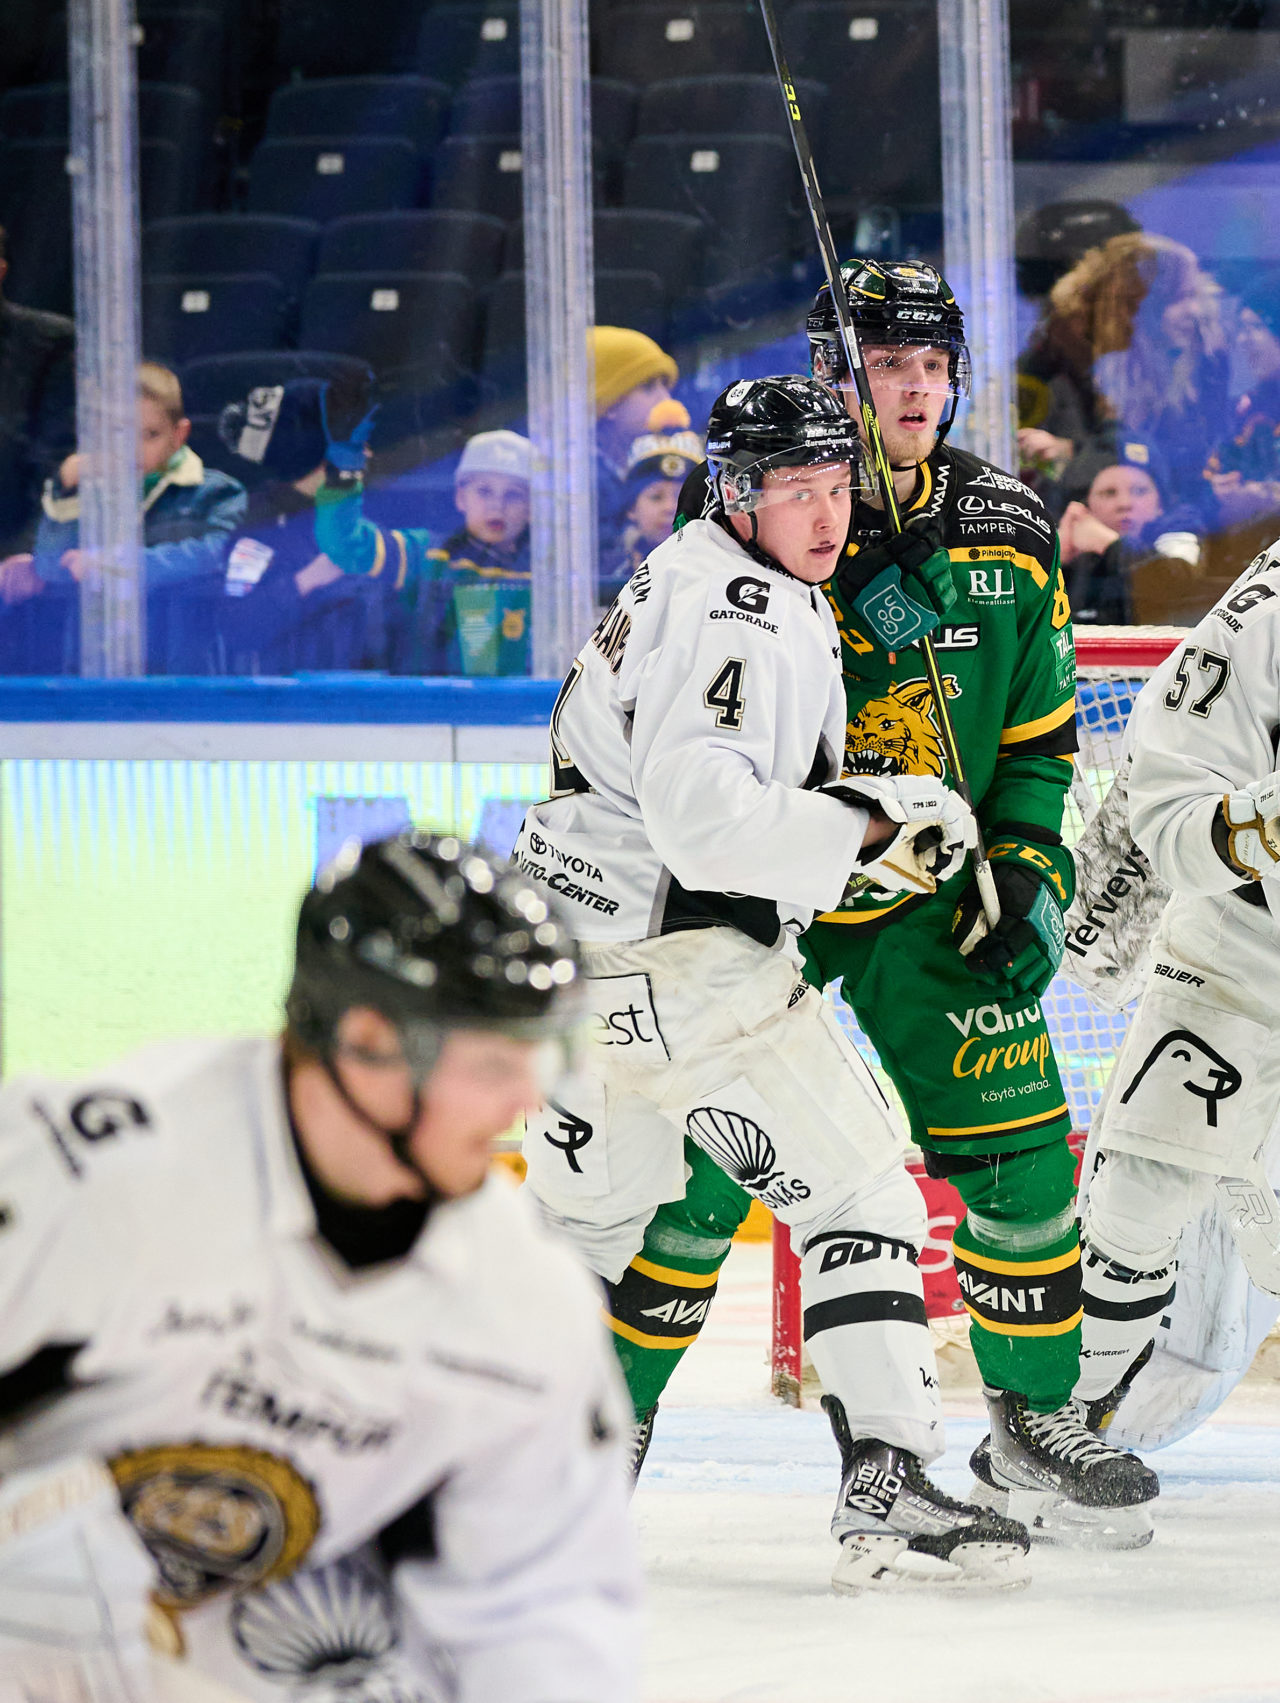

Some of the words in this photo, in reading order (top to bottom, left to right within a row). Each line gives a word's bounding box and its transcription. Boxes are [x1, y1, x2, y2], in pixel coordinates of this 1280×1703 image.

[896, 310, 942, 322] CCM
[987, 500, 1051, 535] LEXUS
[709, 610, 779, 634] GATORADE
[703, 656, 747, 731] 4
[1163, 645, 1231, 718] 57
[1154, 963, 1205, 987] BAUER
[953, 1032, 1050, 1081] Group
[981, 1082, 1016, 1105] Käytä
[957, 1270, 1046, 1312] AVANT
[853, 1481, 894, 1503] STEEL
[857, 1464, 902, 1494] BIO
